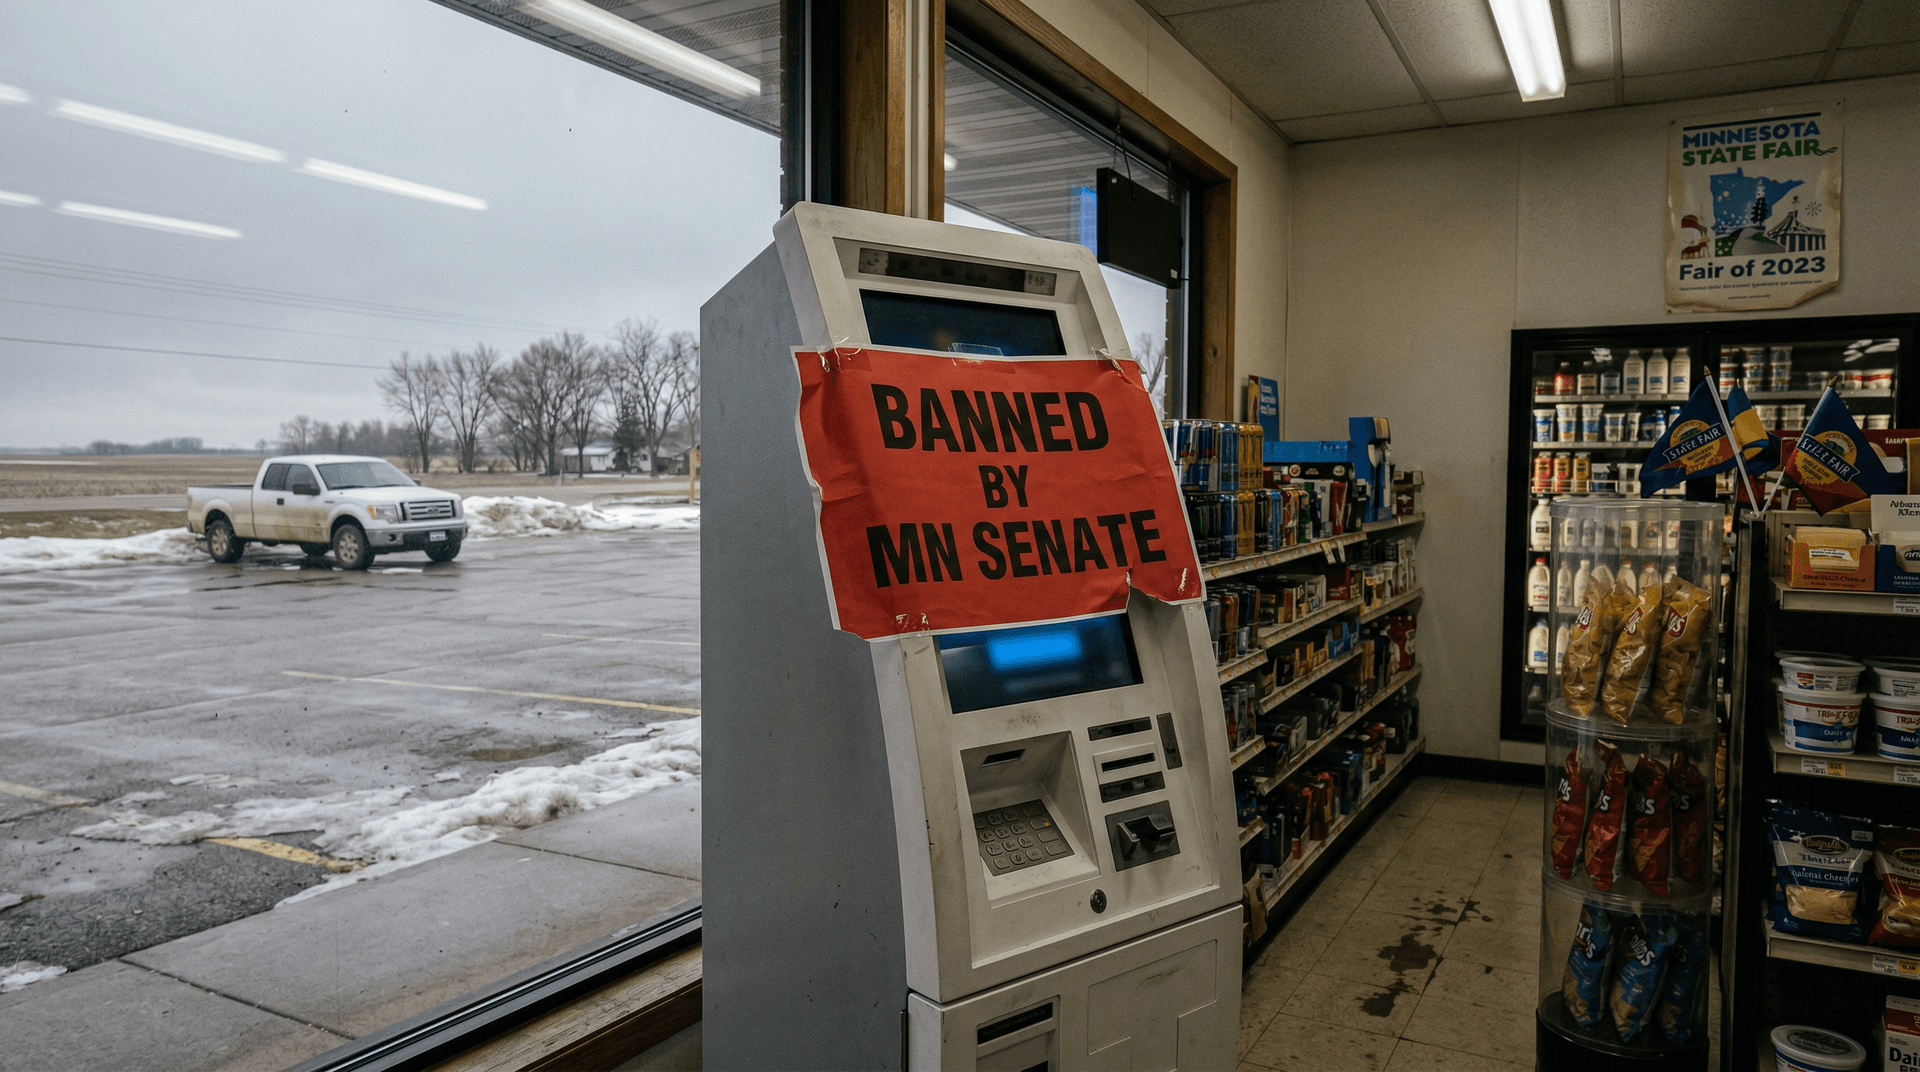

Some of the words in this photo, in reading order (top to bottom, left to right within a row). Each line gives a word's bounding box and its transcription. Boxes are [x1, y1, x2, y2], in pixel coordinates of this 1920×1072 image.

[1682, 120, 1821, 149] MINNESOTA
[1682, 144, 1756, 167] STATE
[1763, 138, 1838, 160] FAIR
[1679, 263, 1725, 281] Fair
[1730, 259, 1755, 278] of
[1761, 256, 1826, 276] 2023
[870, 383, 1110, 453] BANNED
[1697, 427, 1722, 446] FAIR
[1827, 456, 1852, 477] FAIR
[977, 464, 1029, 509] BY
[865, 521, 964, 589] MN
[972, 508, 1168, 581] SENATE
